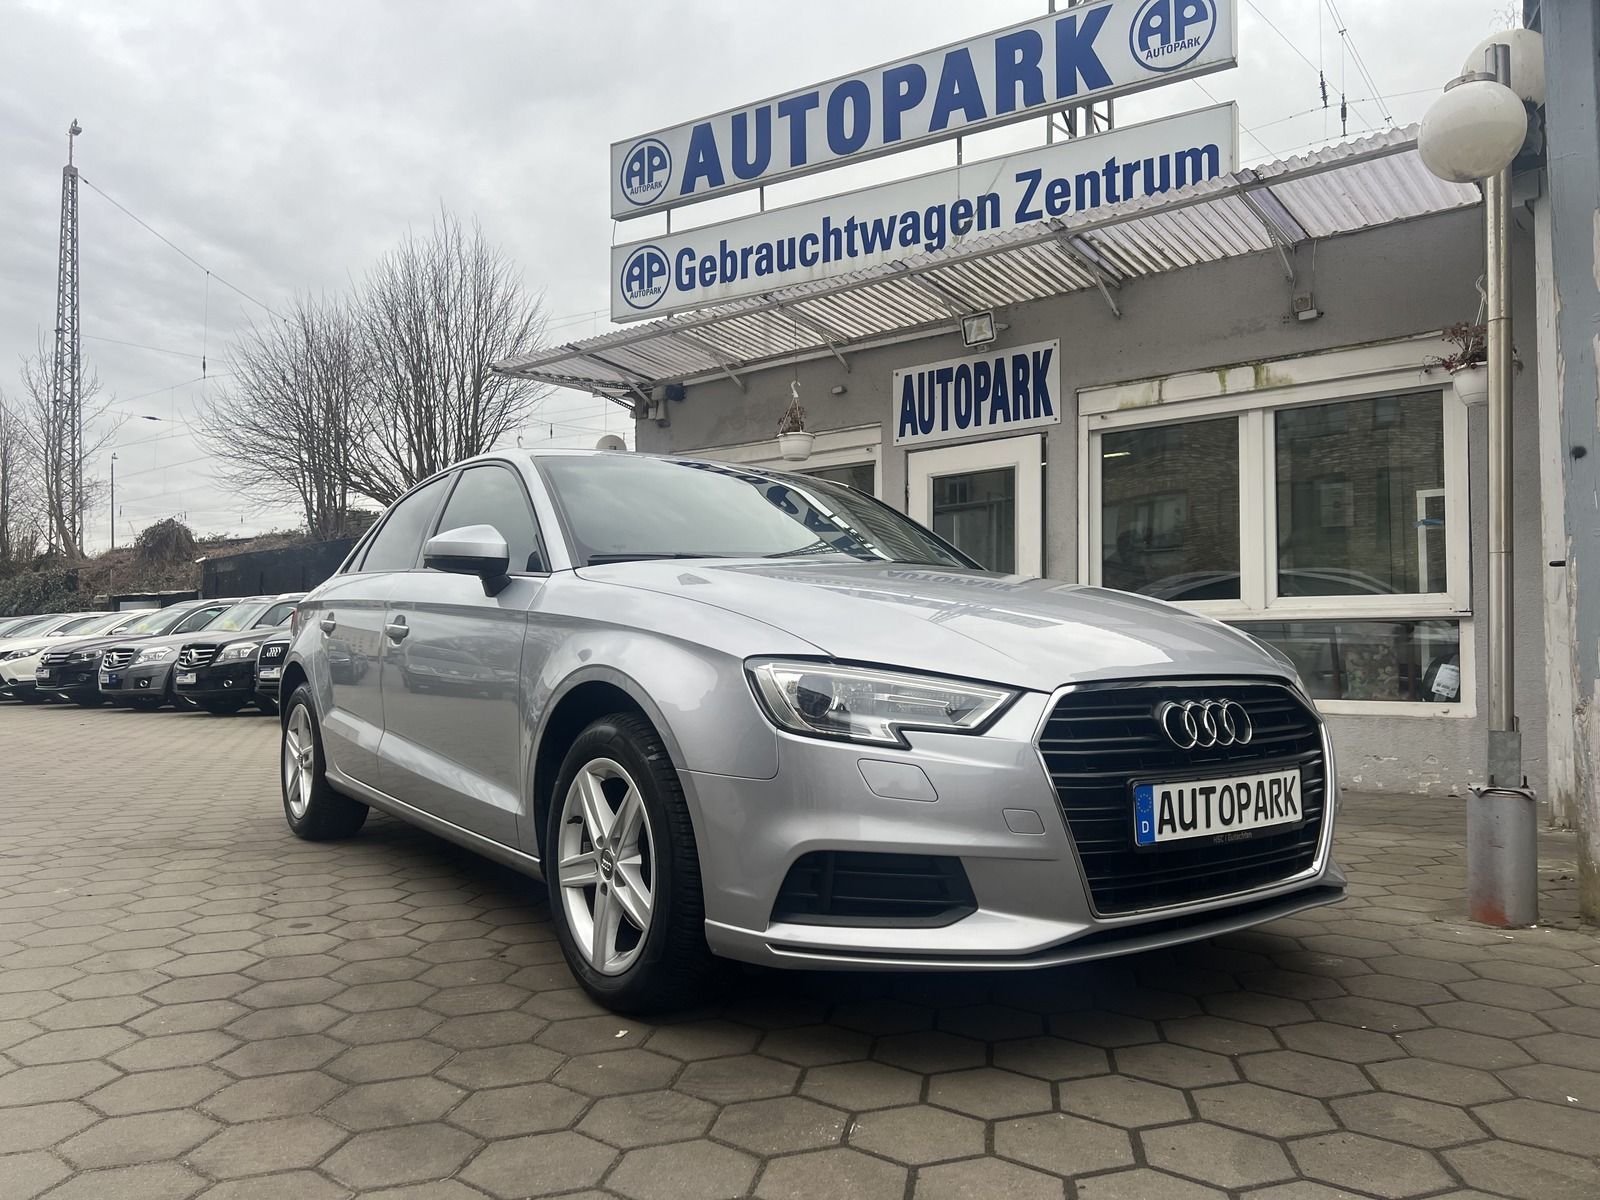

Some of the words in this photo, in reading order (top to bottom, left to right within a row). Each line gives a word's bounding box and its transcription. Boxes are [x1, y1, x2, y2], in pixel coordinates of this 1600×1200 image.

[1138, 0, 1209, 52] AP
[1145, 36, 1201, 60] AUTOPARK
[680, 4, 1114, 195] AUTOPARK
[625, 145, 668, 189] AP
[629, 181, 663, 195] AUTOPARK
[675, 192, 1000, 292] Gebrauchtwagen
[1015, 143, 1220, 224] Zentrum
[625, 252, 667, 293] AP
[629, 286, 662, 299] AUTOPARK
[899, 348, 1054, 438] AUTOPARK
[1141, 820, 1150, 834] D
[1157, 775, 1298, 836] AUTOPARK
